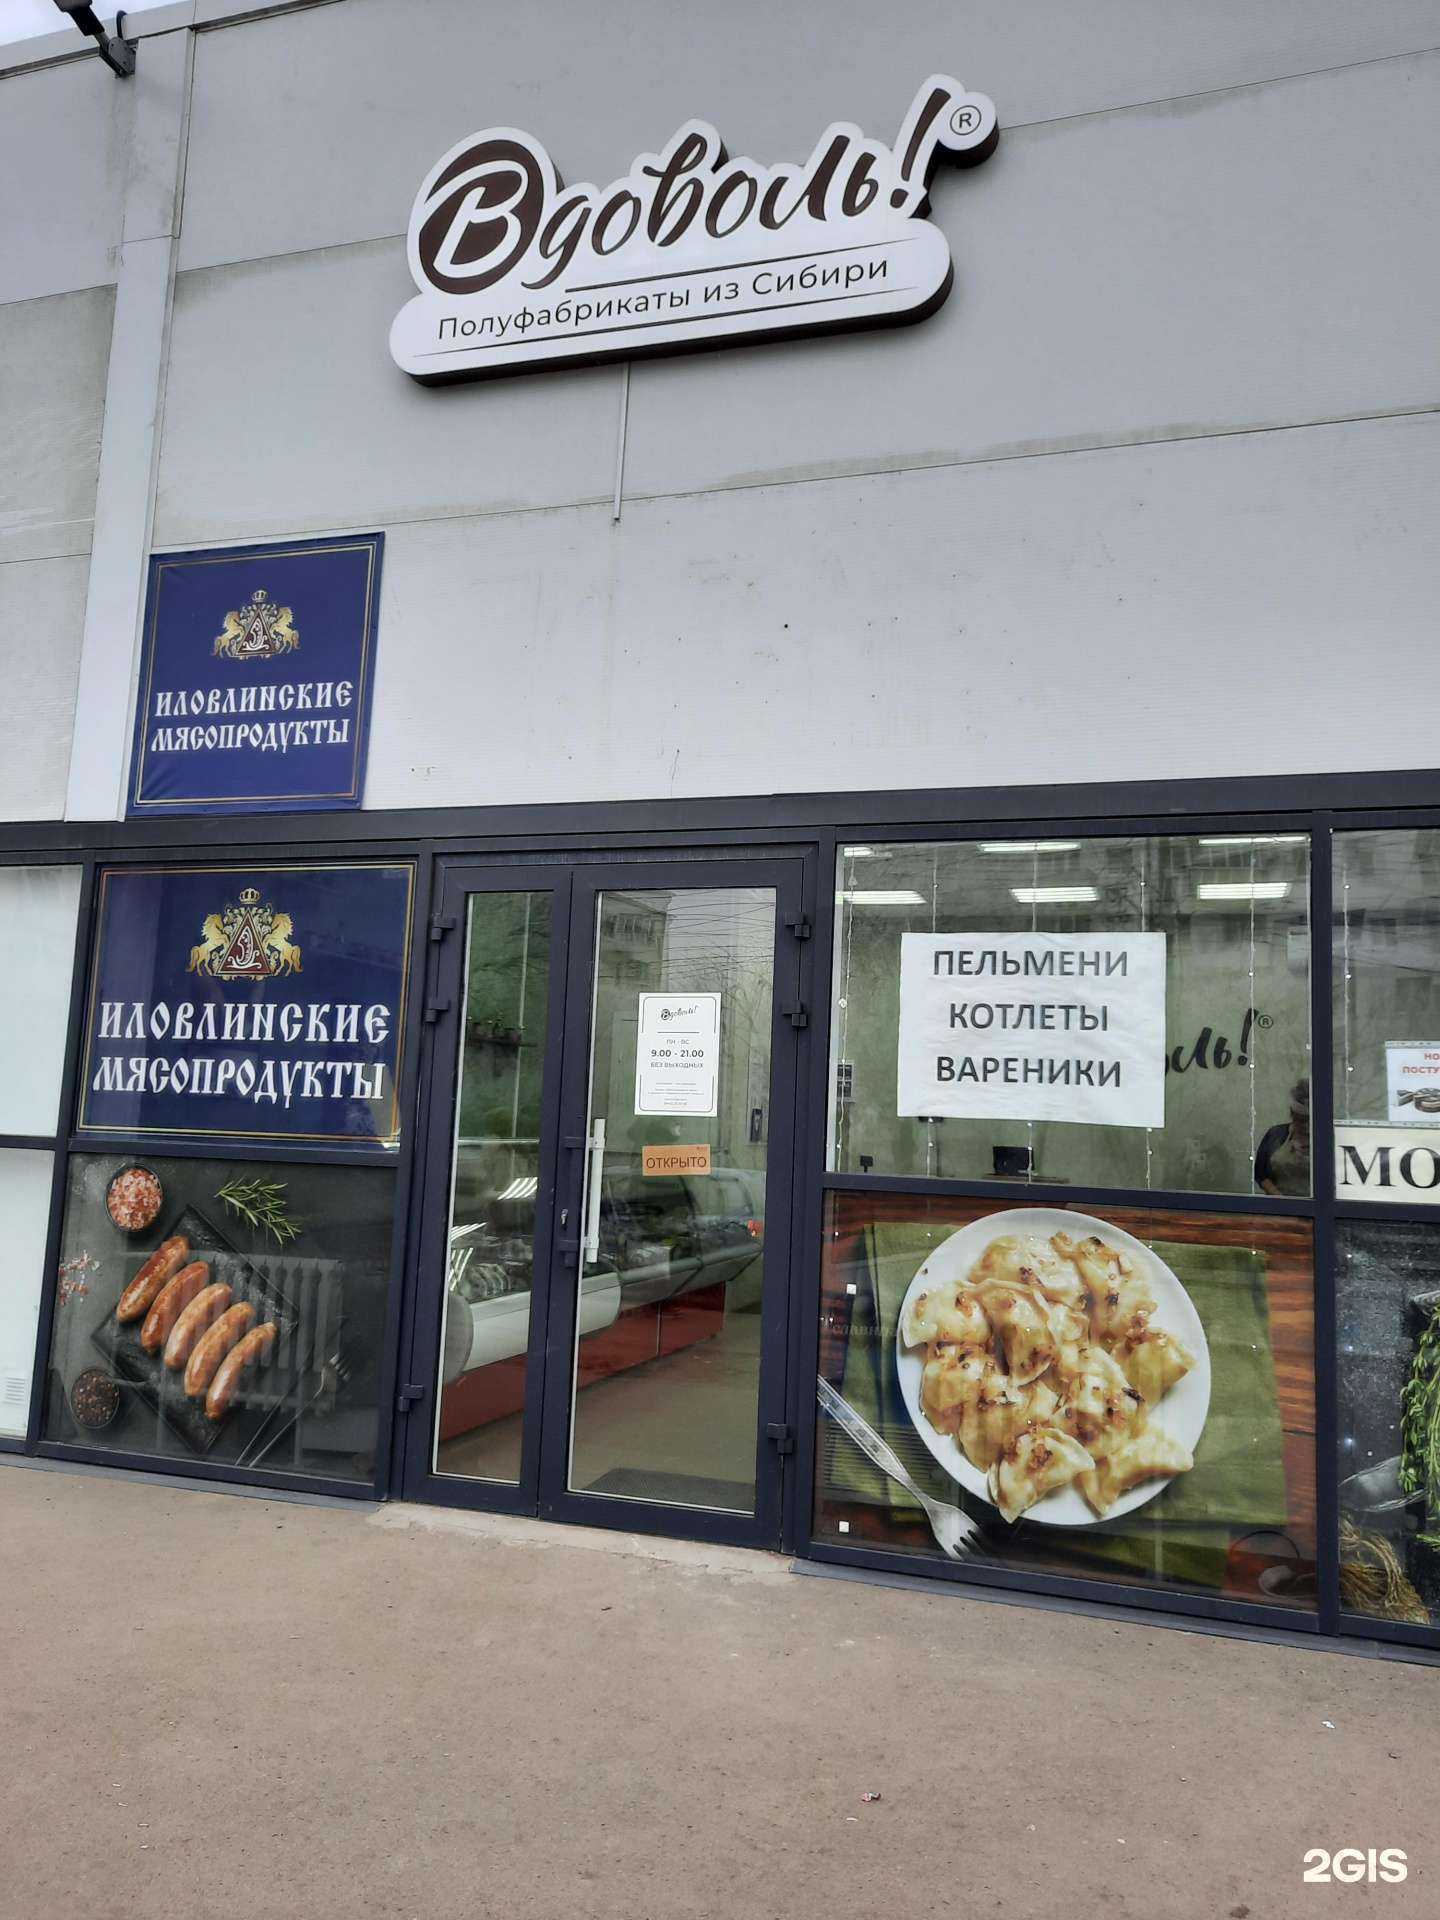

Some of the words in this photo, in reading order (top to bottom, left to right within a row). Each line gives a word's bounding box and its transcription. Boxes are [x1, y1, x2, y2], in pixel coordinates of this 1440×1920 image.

[437, 288, 690, 341] Полуфабрикаты
[703, 282, 740, 303] из
[751, 257, 889, 298] Сибири
[154, 680, 355, 718] ИЛОВЛИНСКИЕ
[150, 718, 351, 755] МЯСОПРОДУКТЫ
[932, 949, 1129, 978] ПЕЛЬМЕНИ
[97, 1000, 391, 1044] ИЛОВЛИНСКИЕ
[948, 1001, 1109, 1033] КОТЛЕТЫ
[650, 1061, 663, 1069] БЕЗ
[664, 1061, 704, 1070] ВЫХОДНЫХ
[651, 1049, 673, 1059] 9.00
[680, 1049, 704, 1059] 21.00
[92, 1054, 386, 1109] МЯСОПРОДУКТЫ
[935, 1055, 1122, 1089] ВАРЕНИКИ
[646, 1156, 707, 1170] ОТКРЫТО
